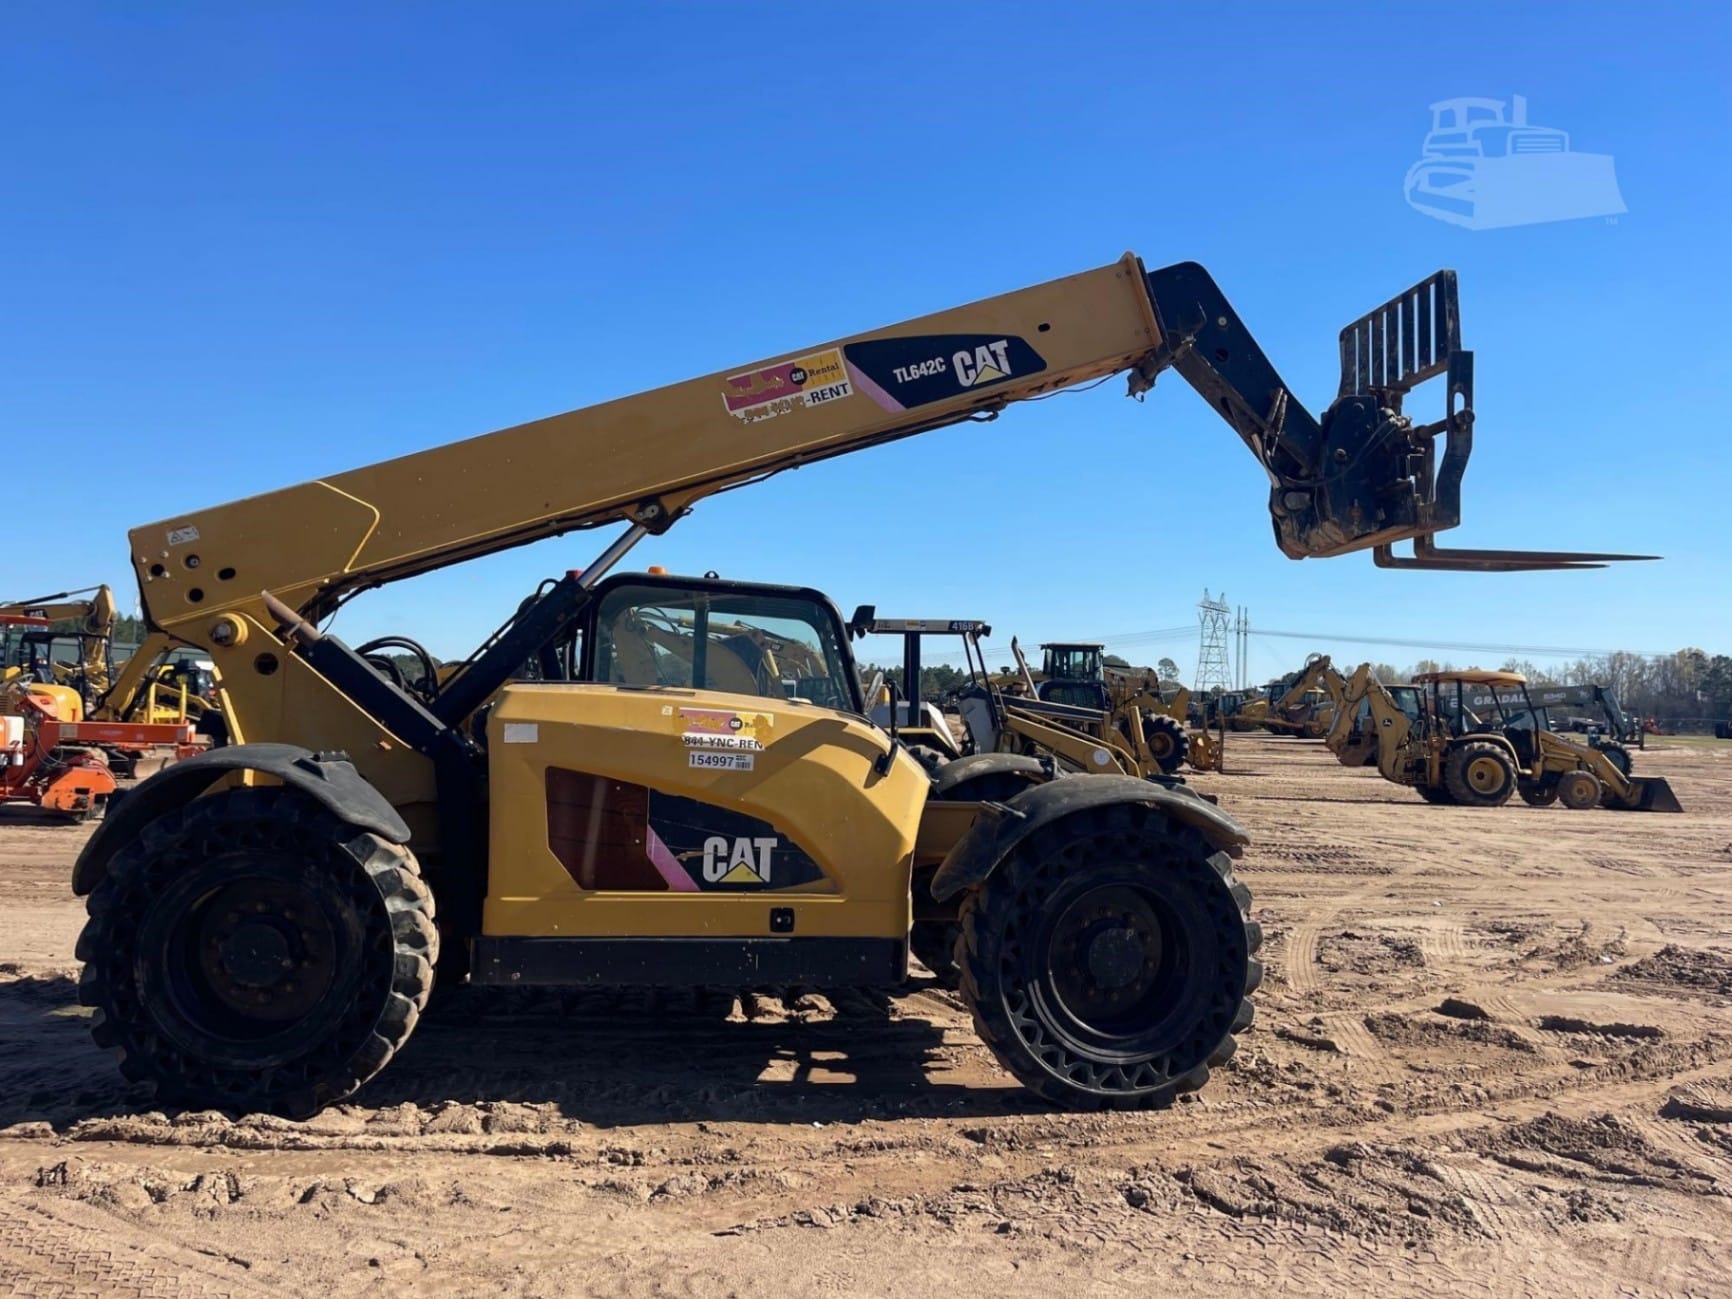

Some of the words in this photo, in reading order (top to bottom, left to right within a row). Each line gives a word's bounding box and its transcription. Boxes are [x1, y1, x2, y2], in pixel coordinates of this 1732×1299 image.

[808, 362, 839, 377] Rental
[893, 357, 946, 383] TL642C
[952, 339, 1012, 387] CAT
[1473, 693, 1532, 706] GRADAL
[691, 754, 734, 767] 154997
[703, 836, 778, 883] CAT
